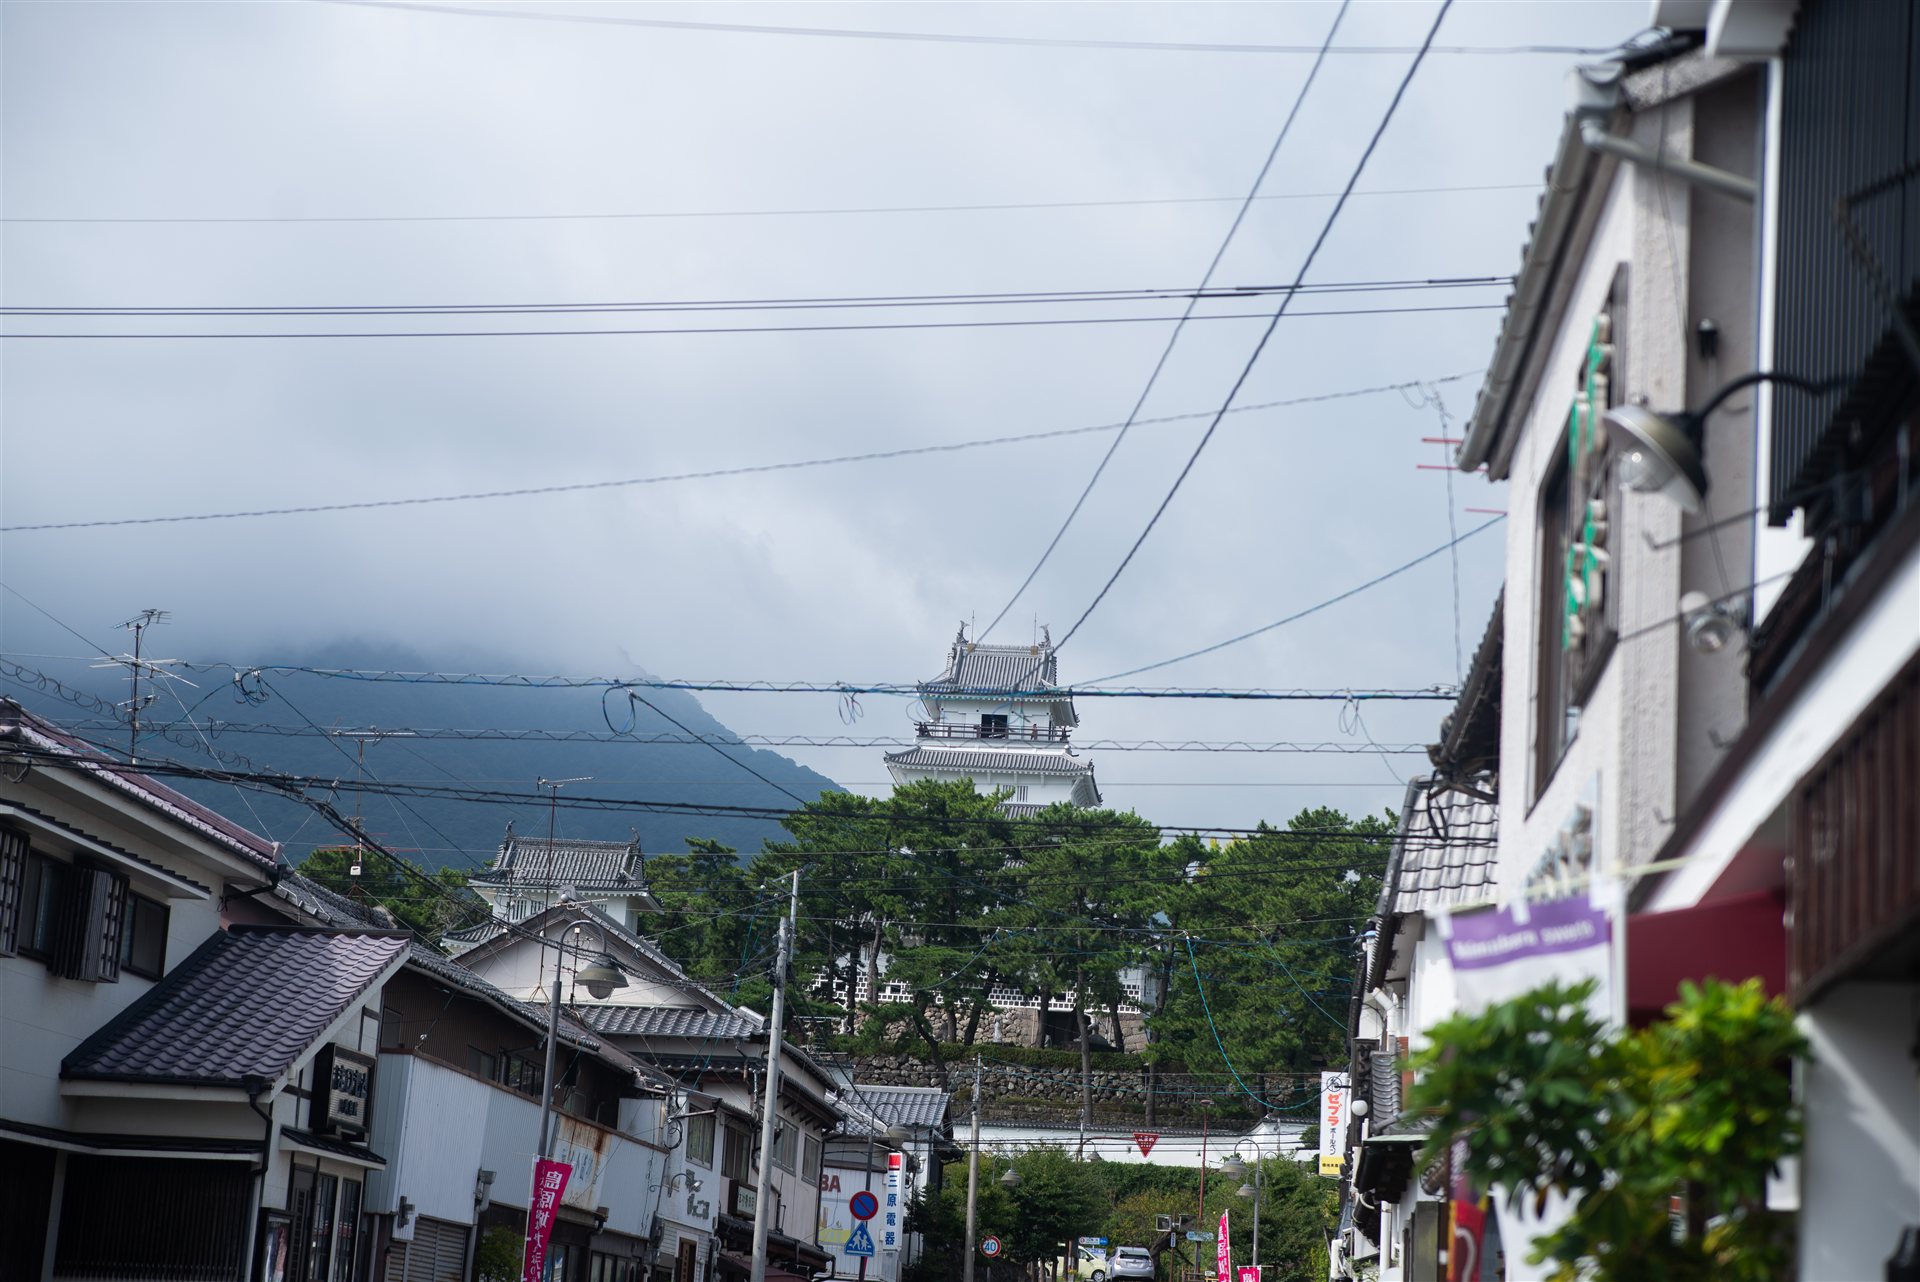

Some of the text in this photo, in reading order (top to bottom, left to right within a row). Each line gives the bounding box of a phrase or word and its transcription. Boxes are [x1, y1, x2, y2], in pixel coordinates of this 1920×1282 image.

[1327, 1092, 1343, 1126] ゼブラ
[884, 1174, 897, 1246] 三原電器
[984, 1241, 996, 1252] 40
